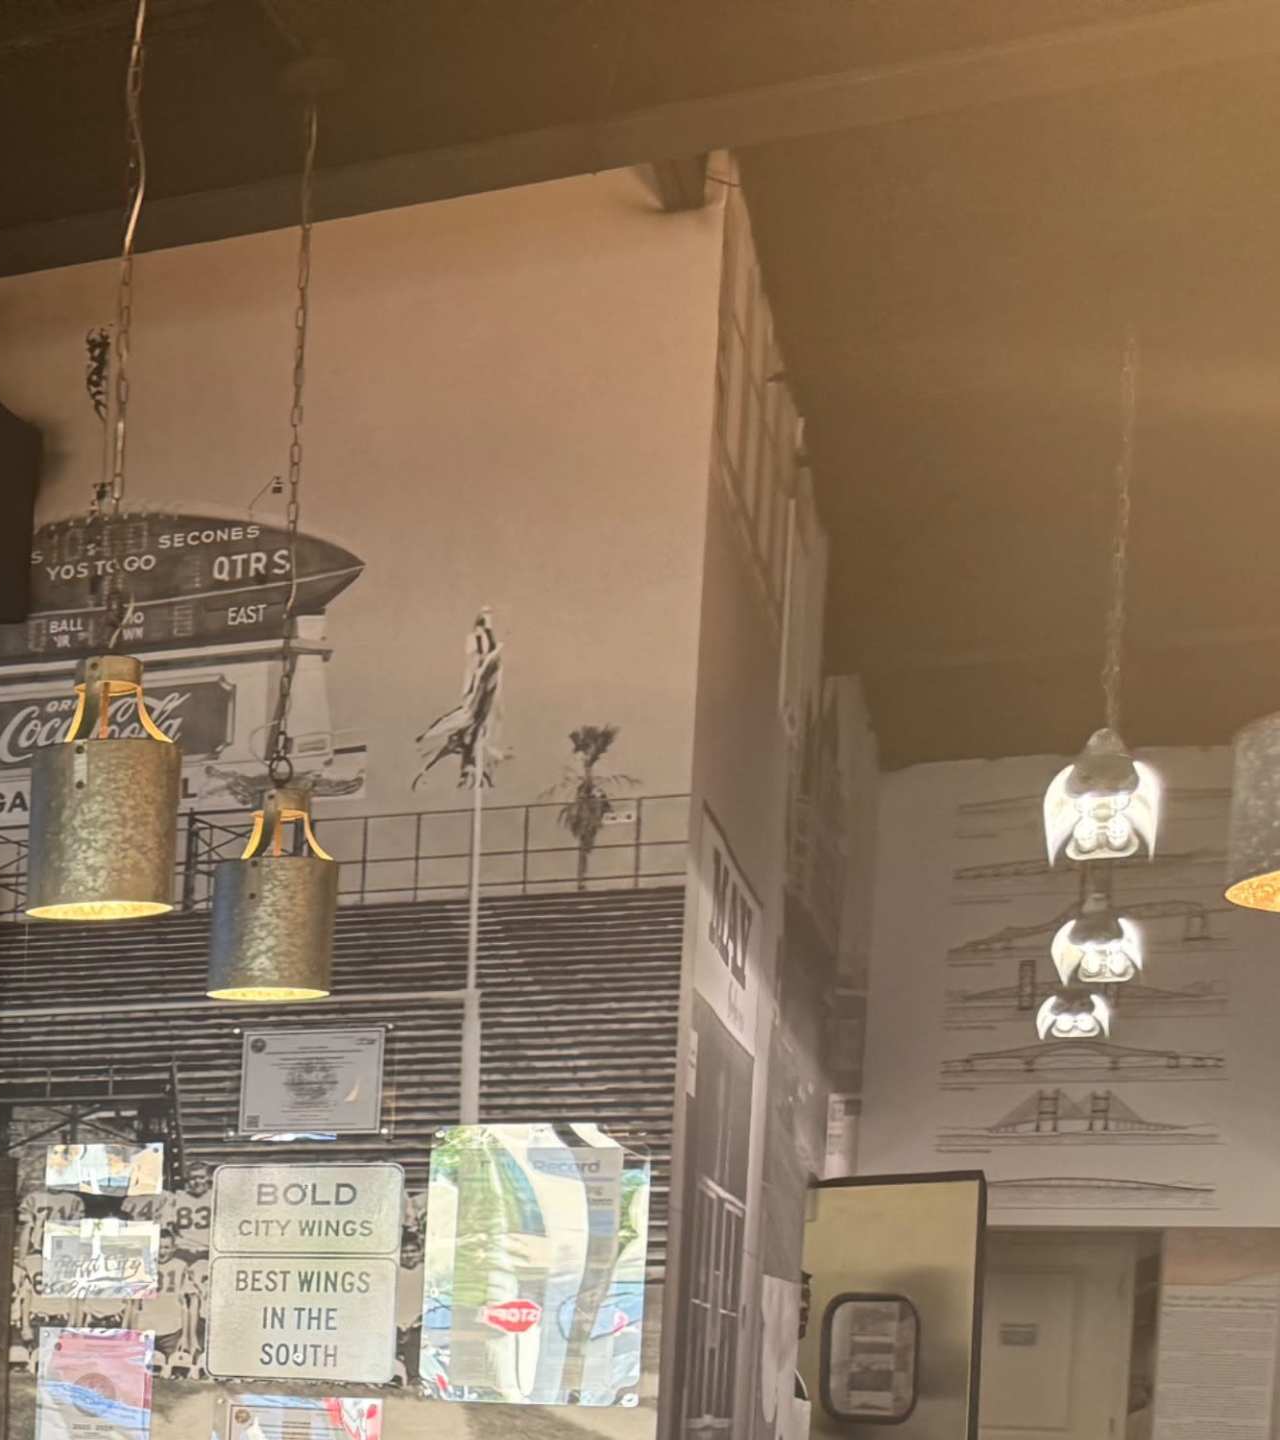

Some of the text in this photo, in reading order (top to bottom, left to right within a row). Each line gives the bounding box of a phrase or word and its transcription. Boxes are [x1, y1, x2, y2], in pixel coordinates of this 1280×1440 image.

[123, 555, 156, 571] GO
[212, 549, 290, 582] QTRS
[49, 618, 84, 634] BALL
[227, 603, 268, 626] EAST
[256, 1183, 358, 1206] BOLD
[176, 1206, 212, 1230] 83
[238, 1219, 374, 1238] CITY WINGS
[235, 1269, 371, 1294] BEST WINGS
[262, 1306, 338, 1331] IN THE
[259, 1342, 338, 1367] SOUTH
